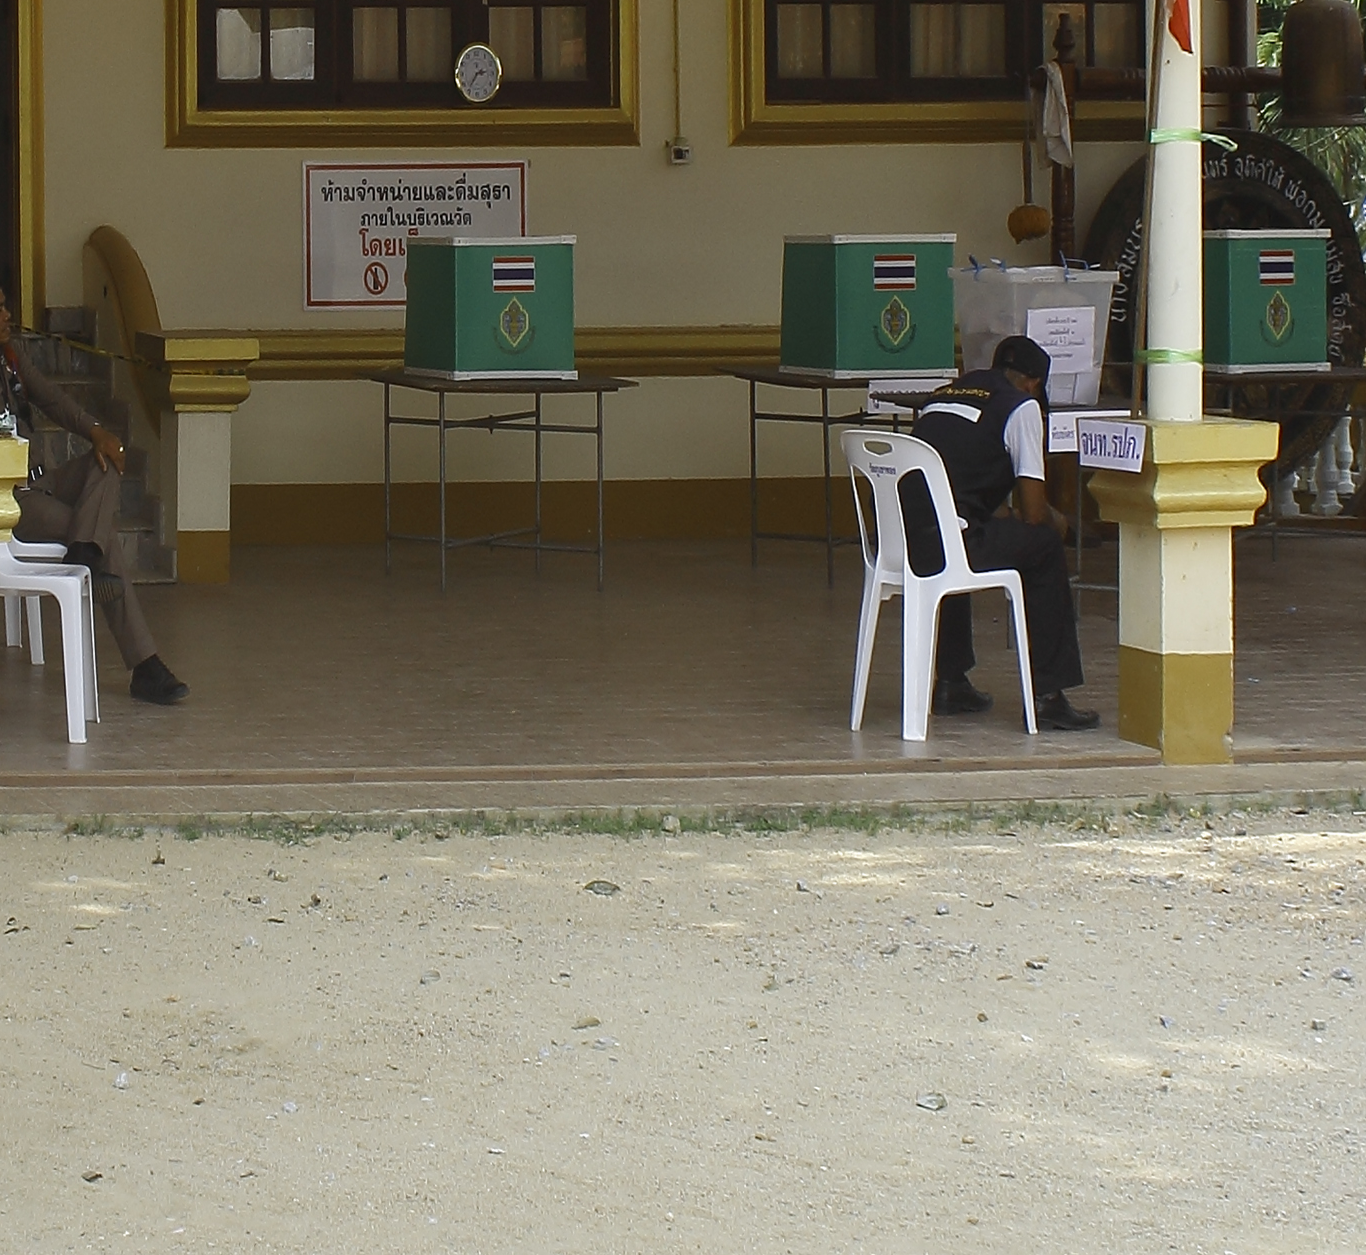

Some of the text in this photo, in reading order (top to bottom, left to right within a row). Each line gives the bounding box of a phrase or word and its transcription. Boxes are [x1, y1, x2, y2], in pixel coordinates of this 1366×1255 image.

[321, 173, 512, 209] ห้ามจำหน่ายและดื่มสุรา
[360, 206, 472, 228] ภายในบริเวณวัด
